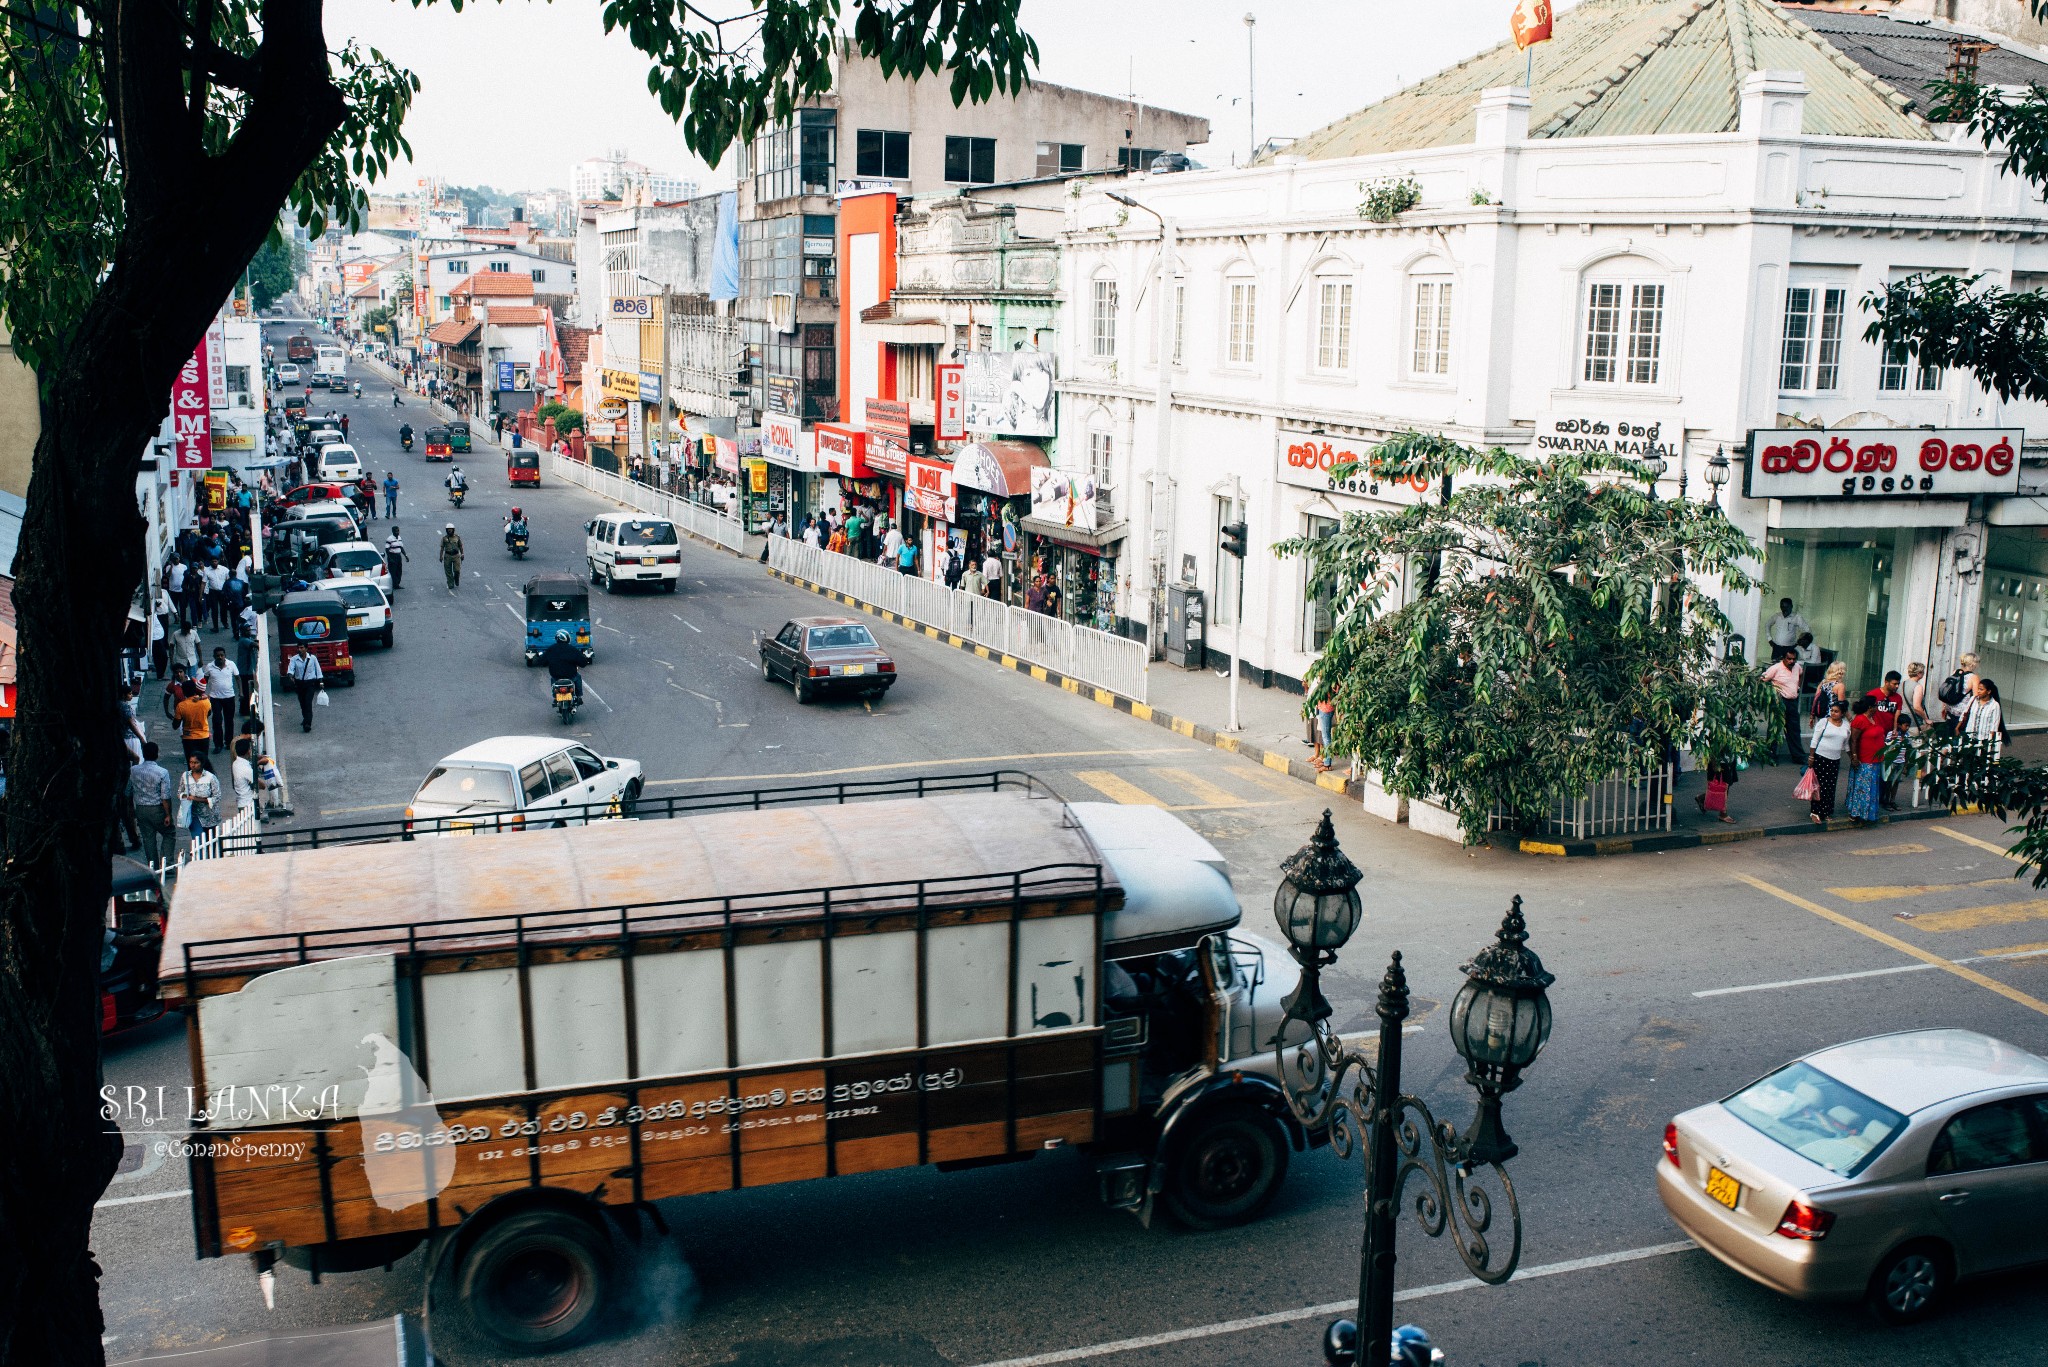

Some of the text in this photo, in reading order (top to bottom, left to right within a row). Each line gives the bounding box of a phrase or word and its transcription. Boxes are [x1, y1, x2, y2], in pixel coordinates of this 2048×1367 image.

[613, 298, 648, 315] සීවලි
[177, 389, 204, 409] &
[946, 372, 961, 418] DSI
[771, 424, 794, 448] ROYAL
[1618, 421, 1662, 441] මහල්
[1537, 435, 1609, 452] SWARNA
[1918, 436, 2015, 476] මහල්
[917, 466, 942, 493] DSI
[478, 1149, 504, 1161] 132
